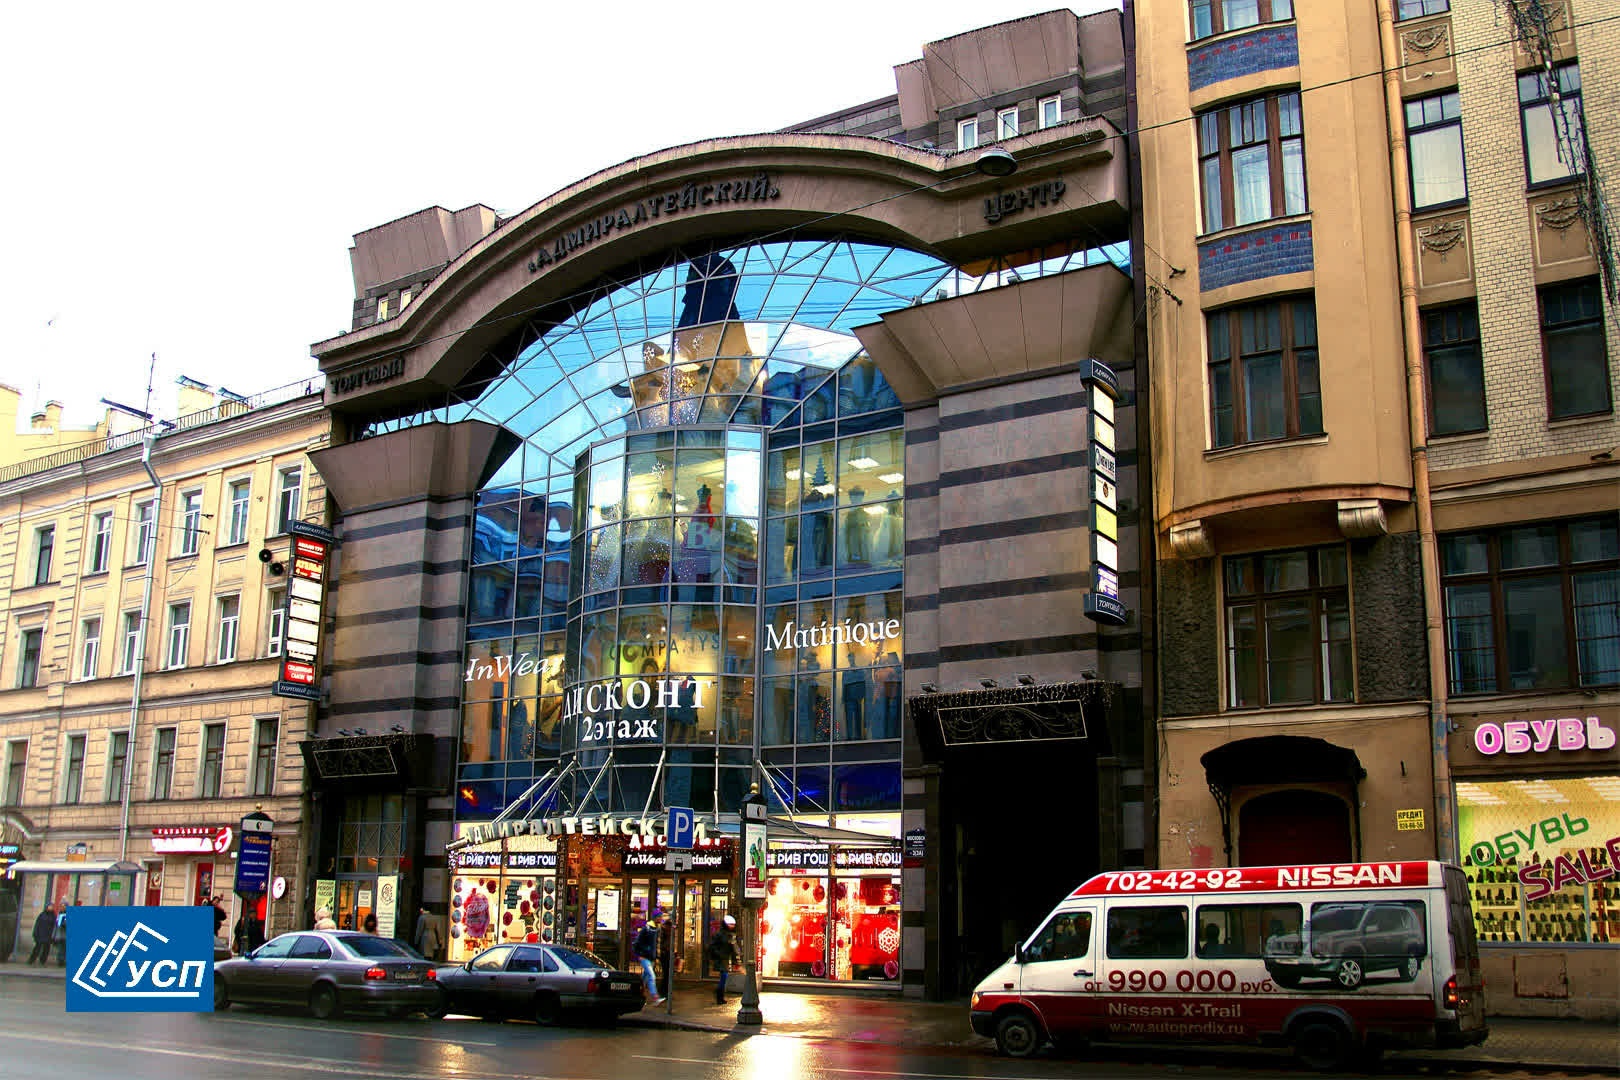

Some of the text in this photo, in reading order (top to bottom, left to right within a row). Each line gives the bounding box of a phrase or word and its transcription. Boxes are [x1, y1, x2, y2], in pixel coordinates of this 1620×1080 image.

[983, 180, 1066, 224] ЦЕНТР
[562, 679, 712, 721] ДИСКОНТ
[582, 716, 657, 742] 2этаж
[1474, 717, 1616, 755] ОБУВЬ
[463, 813, 707, 844] АДМИРАЛТЕЙСКЙ
[1470, 812, 1590, 868] ОБУВЬ
[517, 854, 536, 866] РИВ
[537, 854, 556, 866] ГОШ
[777, 852, 828, 865] РИВ ГОШ
[848, 852, 873, 865] РИВ
[1518, 835, 1620, 902] SALE
[1104, 864, 1402, 891] 702-42-92 NISSAN
[1108, 970, 1167, 992] 990
[1176, 970, 1236, 992] 000
[1240, 979, 1278, 994] руб.
[1108, 1003, 1241, 1017] Nissan X-Trail
